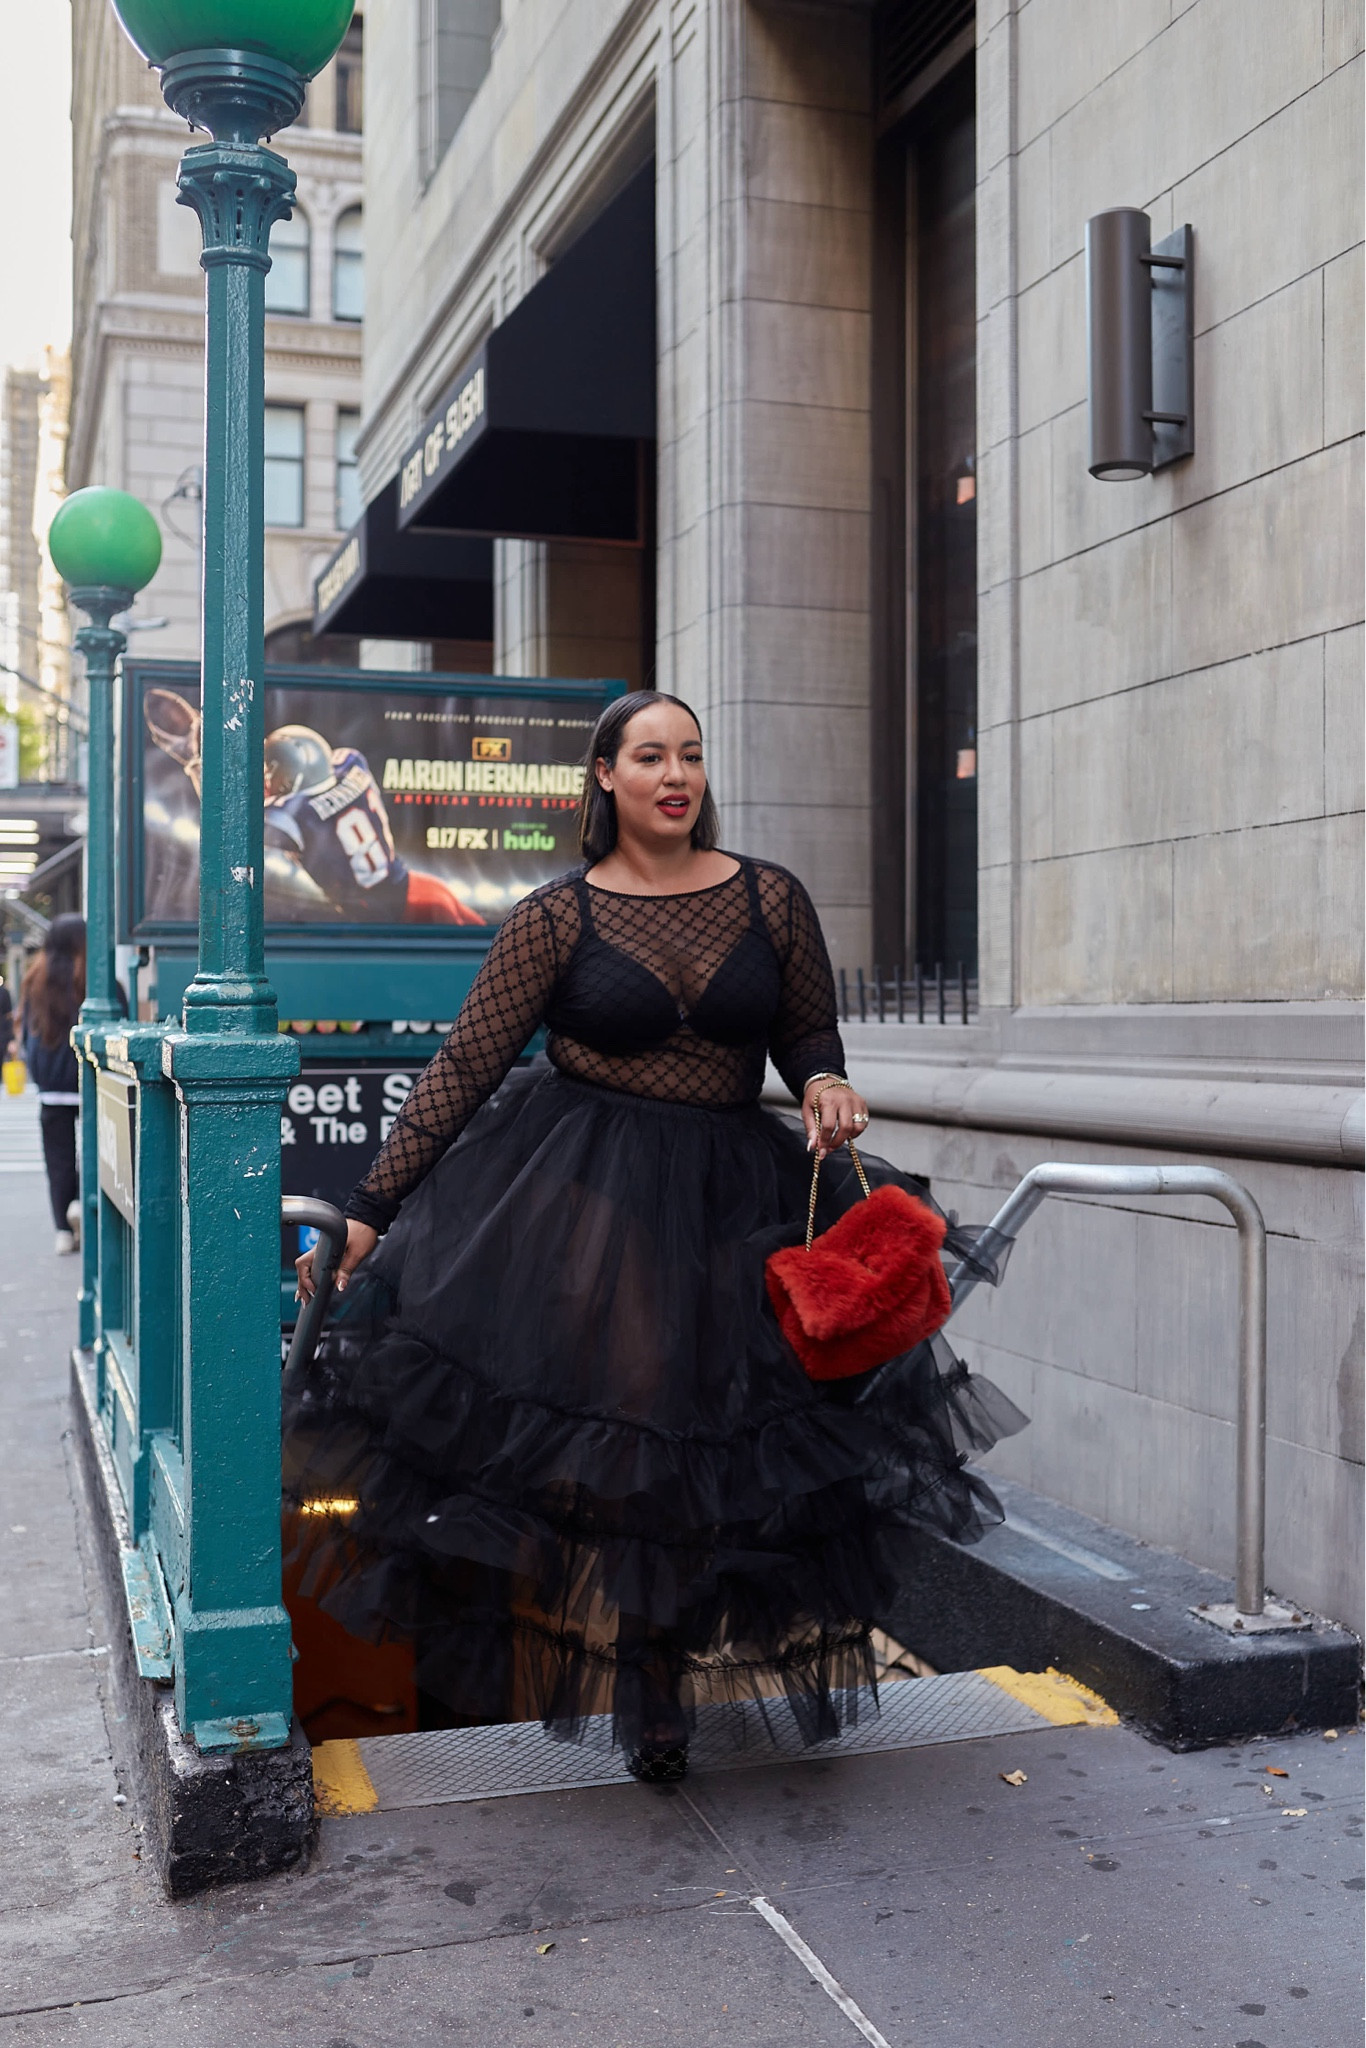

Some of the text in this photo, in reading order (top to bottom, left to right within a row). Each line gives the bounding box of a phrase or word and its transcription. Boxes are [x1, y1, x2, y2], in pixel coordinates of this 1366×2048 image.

[400, 367, 485, 509] ART OF SUSHI
[384, 710, 412, 721] FROM
[382, 757, 588, 796] AARON HERNANDE
[394, 793, 469, 807] AMERICAN
[478, 796, 533, 809] SPORTS
[457, 828, 489, 850] FX
[503, 829, 555, 851] hulu
[287, 1073, 413, 1115] eet S
[309, 1116, 368, 1145] The
